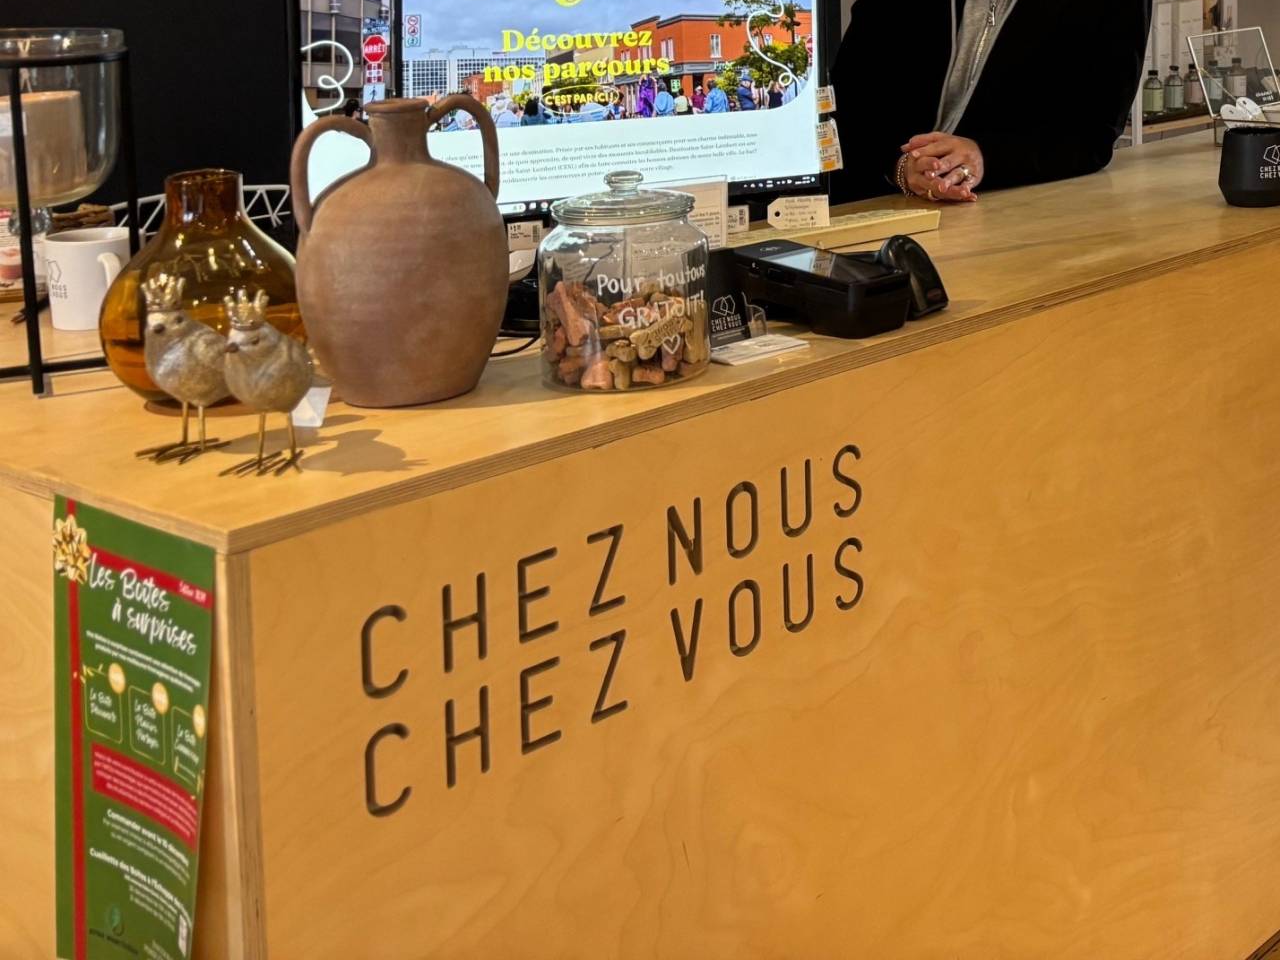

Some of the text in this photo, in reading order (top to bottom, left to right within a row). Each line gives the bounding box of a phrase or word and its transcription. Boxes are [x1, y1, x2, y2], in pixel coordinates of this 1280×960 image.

[364, 43, 386, 53] ARRÊT
[502, 28, 652, 53] Découvrez
[483, 57, 671, 86] nos parcours
[573, 93, 593, 104] PAR
[596, 273, 645, 296] Pour
[89, 552, 115, 590] Les
[120, 568, 171, 612] Boîtes
[361, 524, 627, 699] CHEZ
[667, 444, 863, 586] NOUS
[112, 597, 197, 656] à surprises
[364, 628, 629, 818] CHEZ
[670, 537, 864, 682] VOUS
